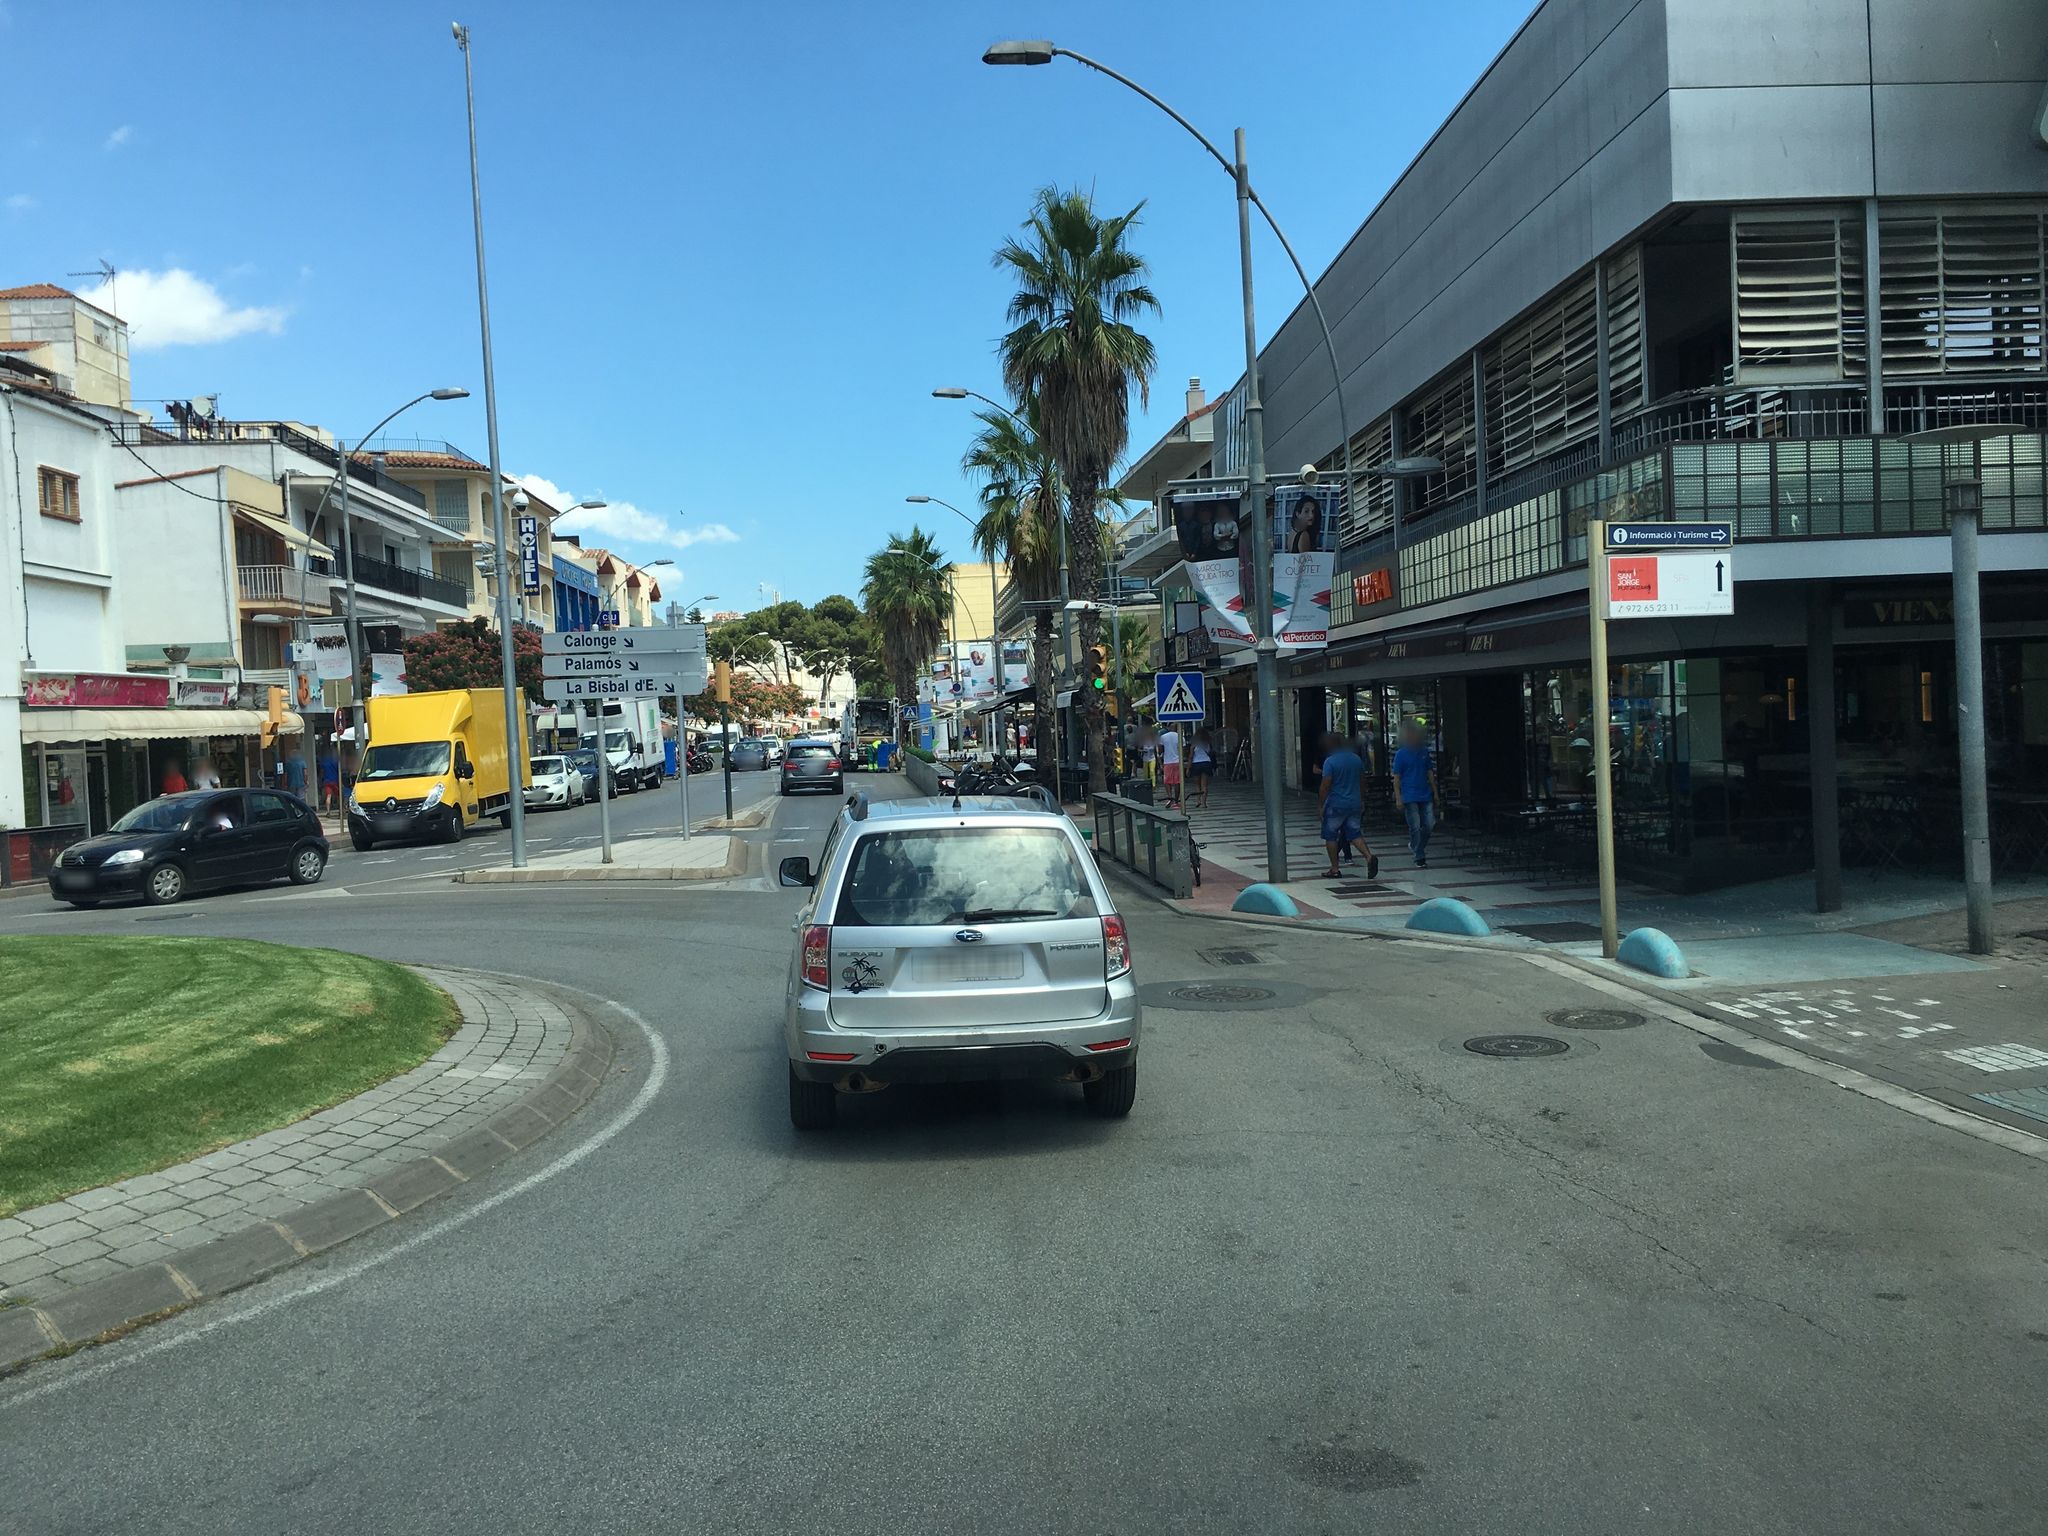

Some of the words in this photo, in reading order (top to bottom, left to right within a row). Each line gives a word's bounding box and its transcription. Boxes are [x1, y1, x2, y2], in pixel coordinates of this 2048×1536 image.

[1629, 530, 1672, 539] Informació
[1678, 531, 1709, 539] Turisme
[520, 519, 537, 585] HOTEL
[1285, 564, 1320, 576] QURTET
[1626, 605, 1642, 613] 972
[1645, 604, 1655, 612] 65
[1657, 604, 1667, 612] 23
[1670, 603, 1679, 611] 11
[564, 634, 617, 649] Calonge
[565, 656, 622, 671] Palamós
[566, 682, 582, 694] La
[588, 679, 629, 693] Bisbal
[634, 679, 658, 692] d'E.
